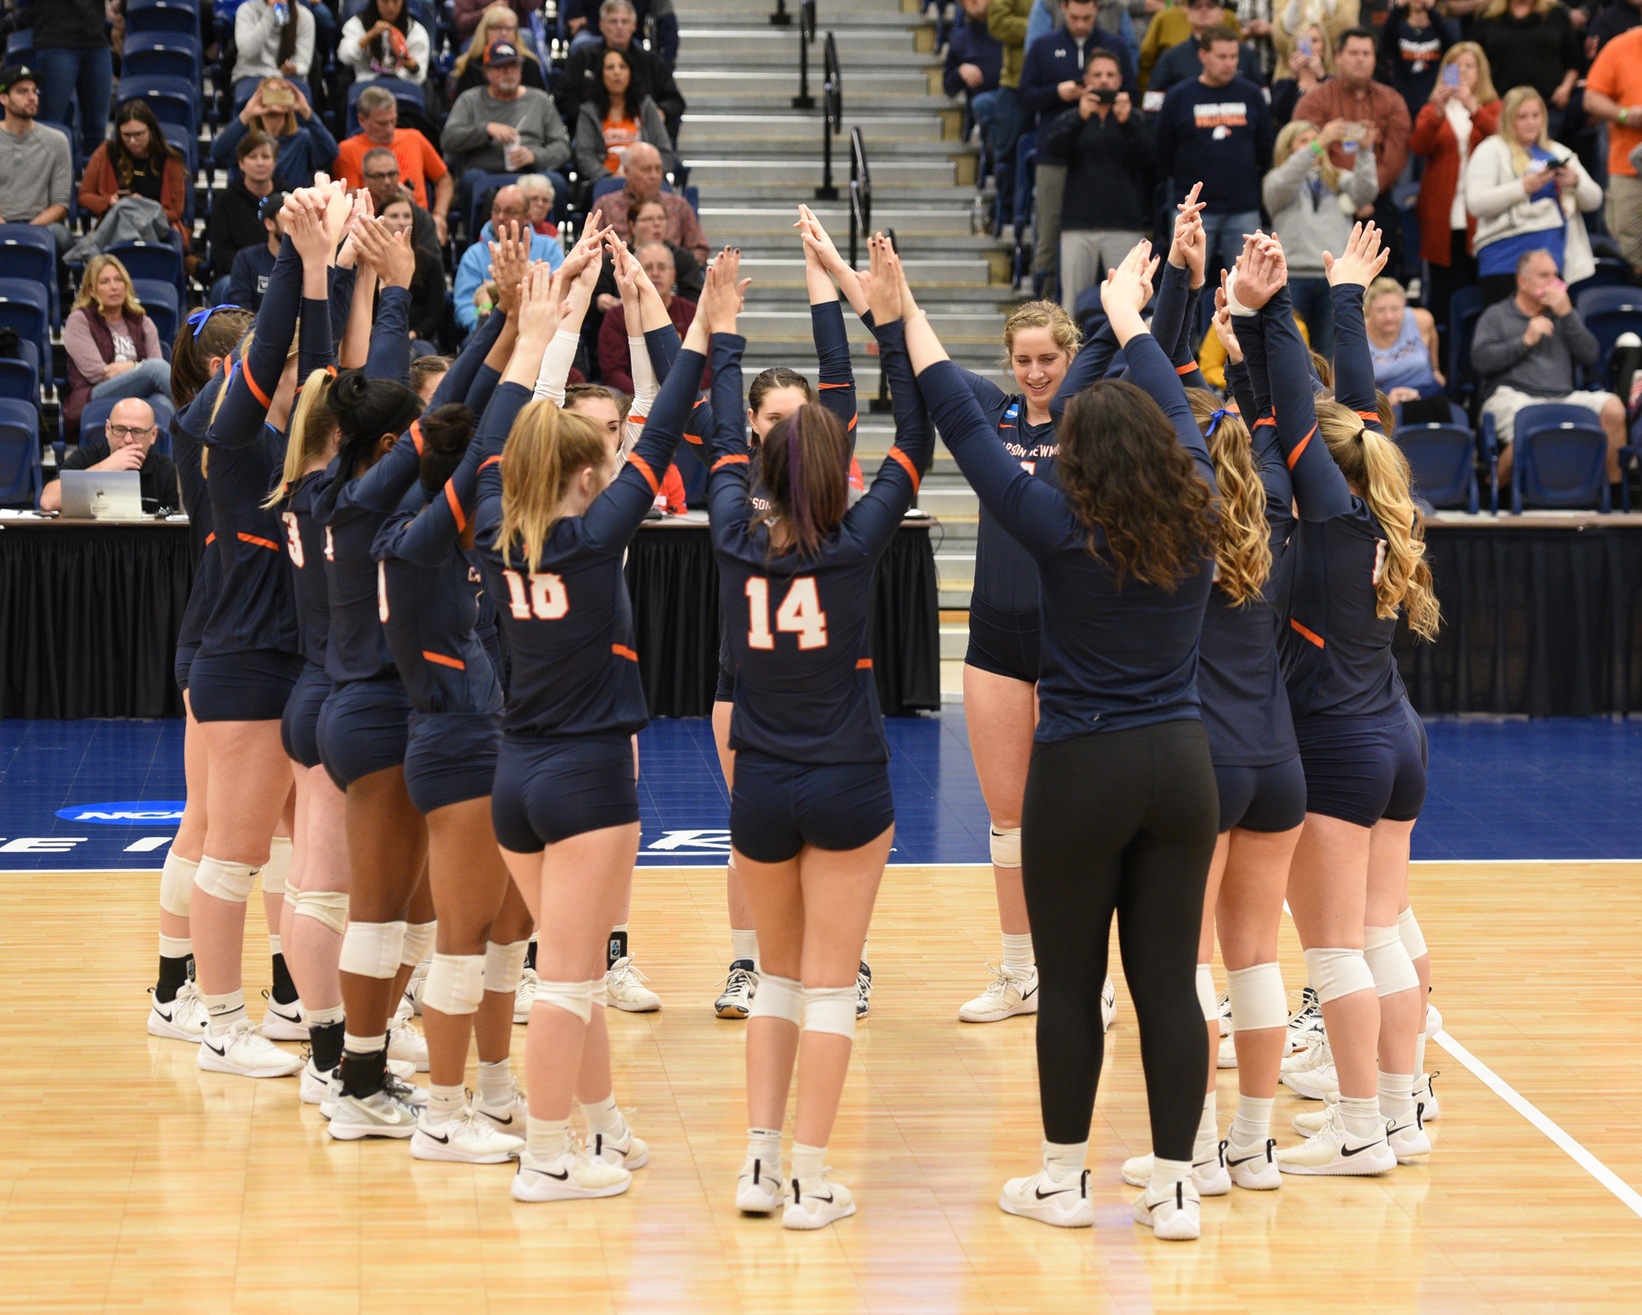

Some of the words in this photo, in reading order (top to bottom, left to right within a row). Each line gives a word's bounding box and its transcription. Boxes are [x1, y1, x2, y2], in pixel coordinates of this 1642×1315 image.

[750, 497, 771, 510] SON
[744, 575, 829, 651] 14
[0, 837, 88, 853] E
